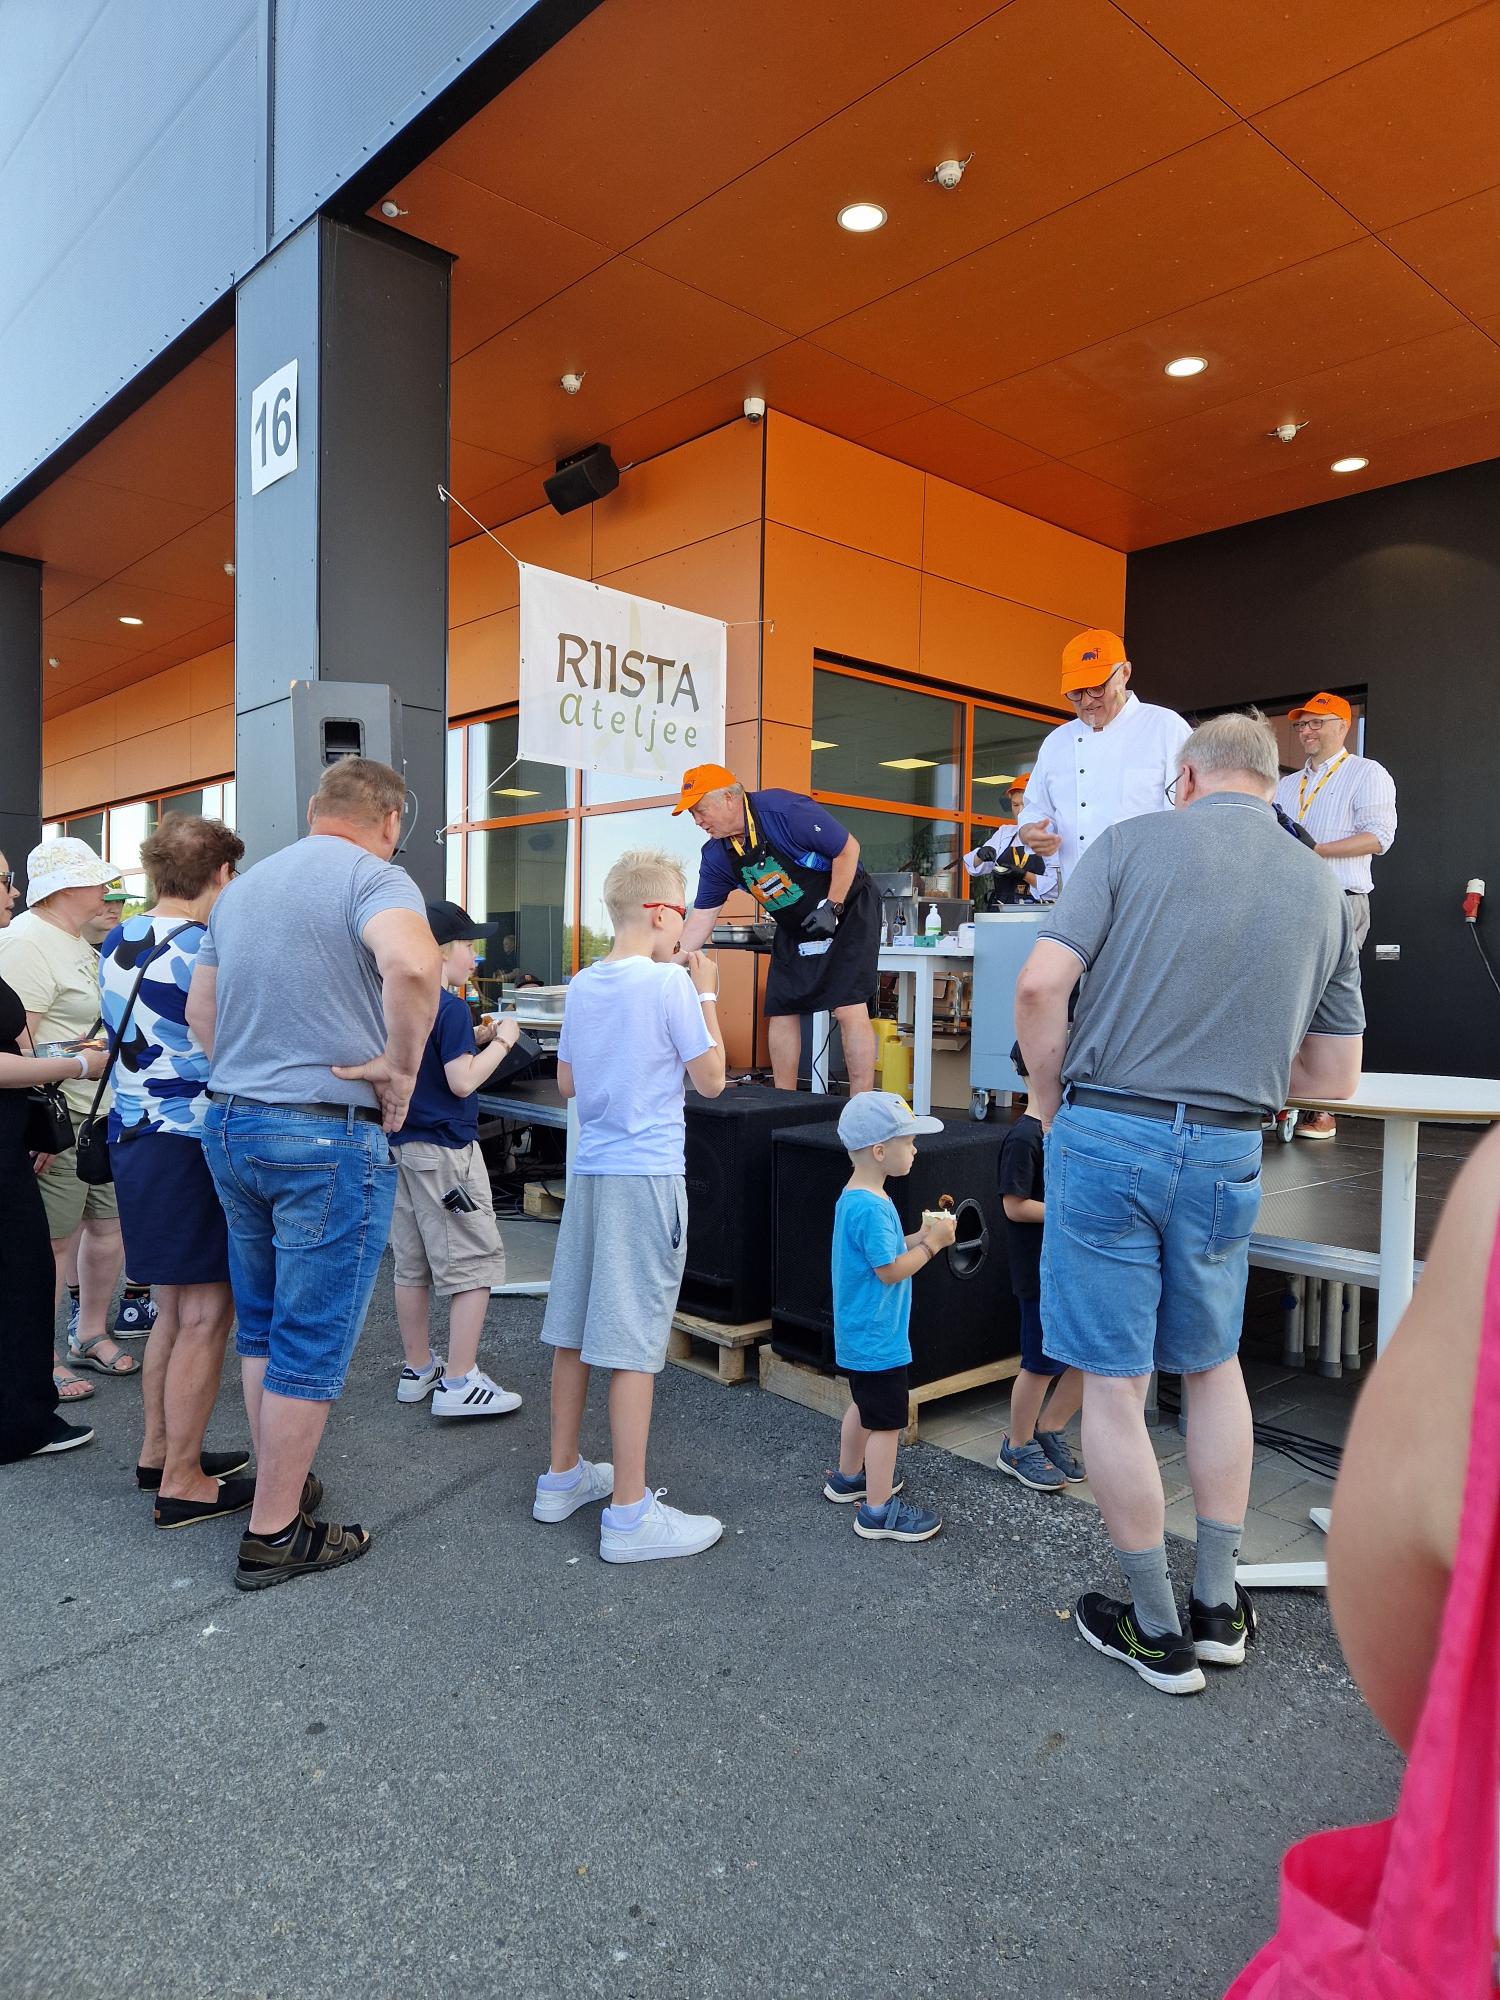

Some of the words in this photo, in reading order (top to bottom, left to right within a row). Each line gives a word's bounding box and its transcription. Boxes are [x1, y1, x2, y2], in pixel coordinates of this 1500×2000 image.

[255, 387, 291, 467] 16
[556, 632, 699, 712] RIISTA
[559, 693, 697, 752] ateljee
